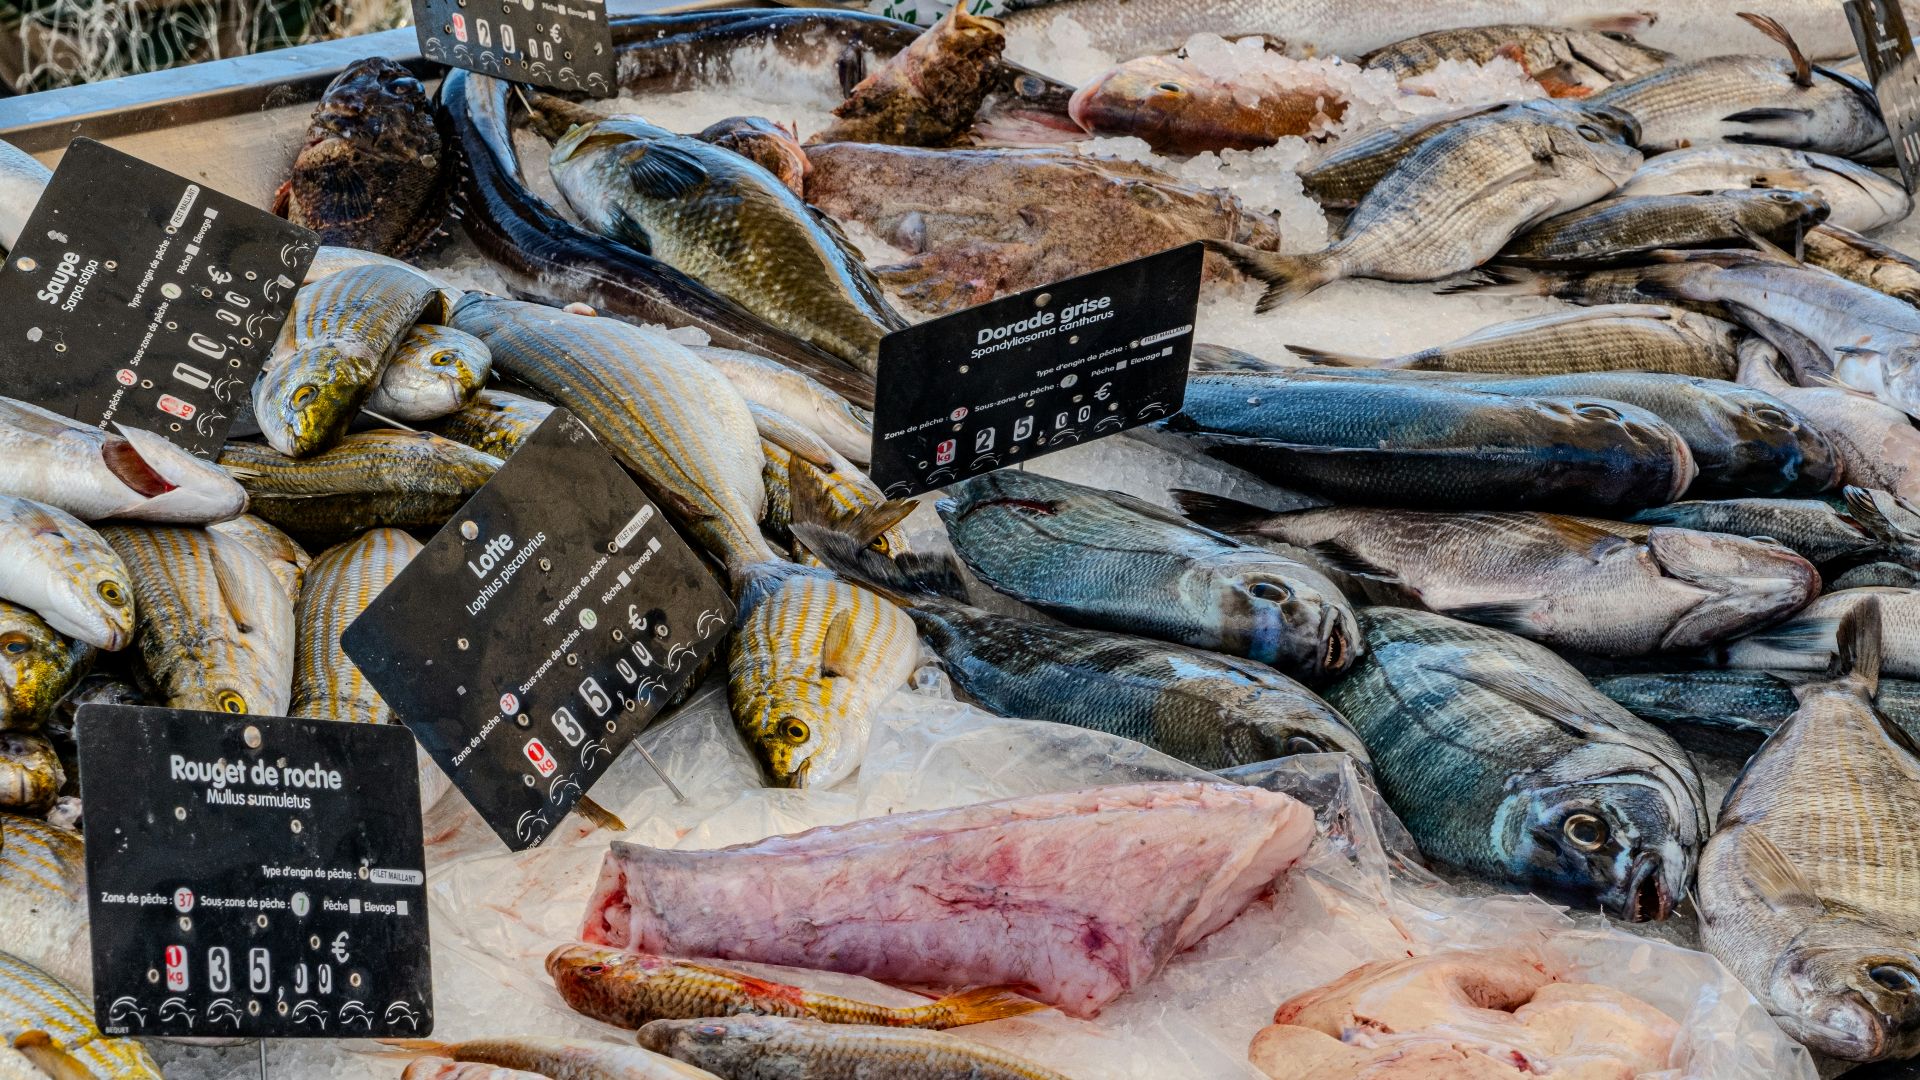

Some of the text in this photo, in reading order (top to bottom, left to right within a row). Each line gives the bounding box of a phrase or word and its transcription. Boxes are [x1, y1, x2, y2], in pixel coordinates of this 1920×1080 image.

[192, 218, 212, 244] Elevage
[37, 252, 80, 304] Saupe
[61, 259, 99, 312] Sarpa salpa
[127, 293, 142, 308] Type
[149, 259, 160, 269] de
[977, 296, 1111, 345] Dorade grise
[129, 327, 155, 366] Sous-zone
[148, 318, 161, 331] de
[971, 310, 1114, 359] Spondyliosoma cantharus
[1036, 367, 1054, 377] Type
[1086, 354, 1097, 362] de
[102, 410, 113, 419] de
[178, 404, 193, 417] kg
[974, 396, 1016, 412] Sous-zone
[884, 429, 905, 440] Zone
[937, 453, 951, 463] kg
[467, 534, 514, 579] Lotte
[628, 549, 652, 575] Elevage
[465, 531, 546, 615] Lophius piscatorius
[542, 605, 563, 625] Type
[580, 576, 590, 587] de
[518, 658, 553, 694] Sous-zone
[551, 649, 561, 660] de
[451, 746, 472, 766] Zone
[470, 736, 481, 748] de
[170, 754, 342, 789] Rouget de roche
[537, 758, 555, 773] kg
[206, 788, 311, 809] Mullus surmuletus
[261, 865, 281, 878] Type
[314, 867, 326, 878] de
[372, 869, 416, 883] FILET MAILLANT
[101, 891, 125, 903] Zone
[126, 892, 138, 904] de
[200, 895, 246, 907] Sous-zone
[246, 897, 258, 908] de
[363, 901, 396, 915] Elevage
[166, 968, 183, 985] kg
